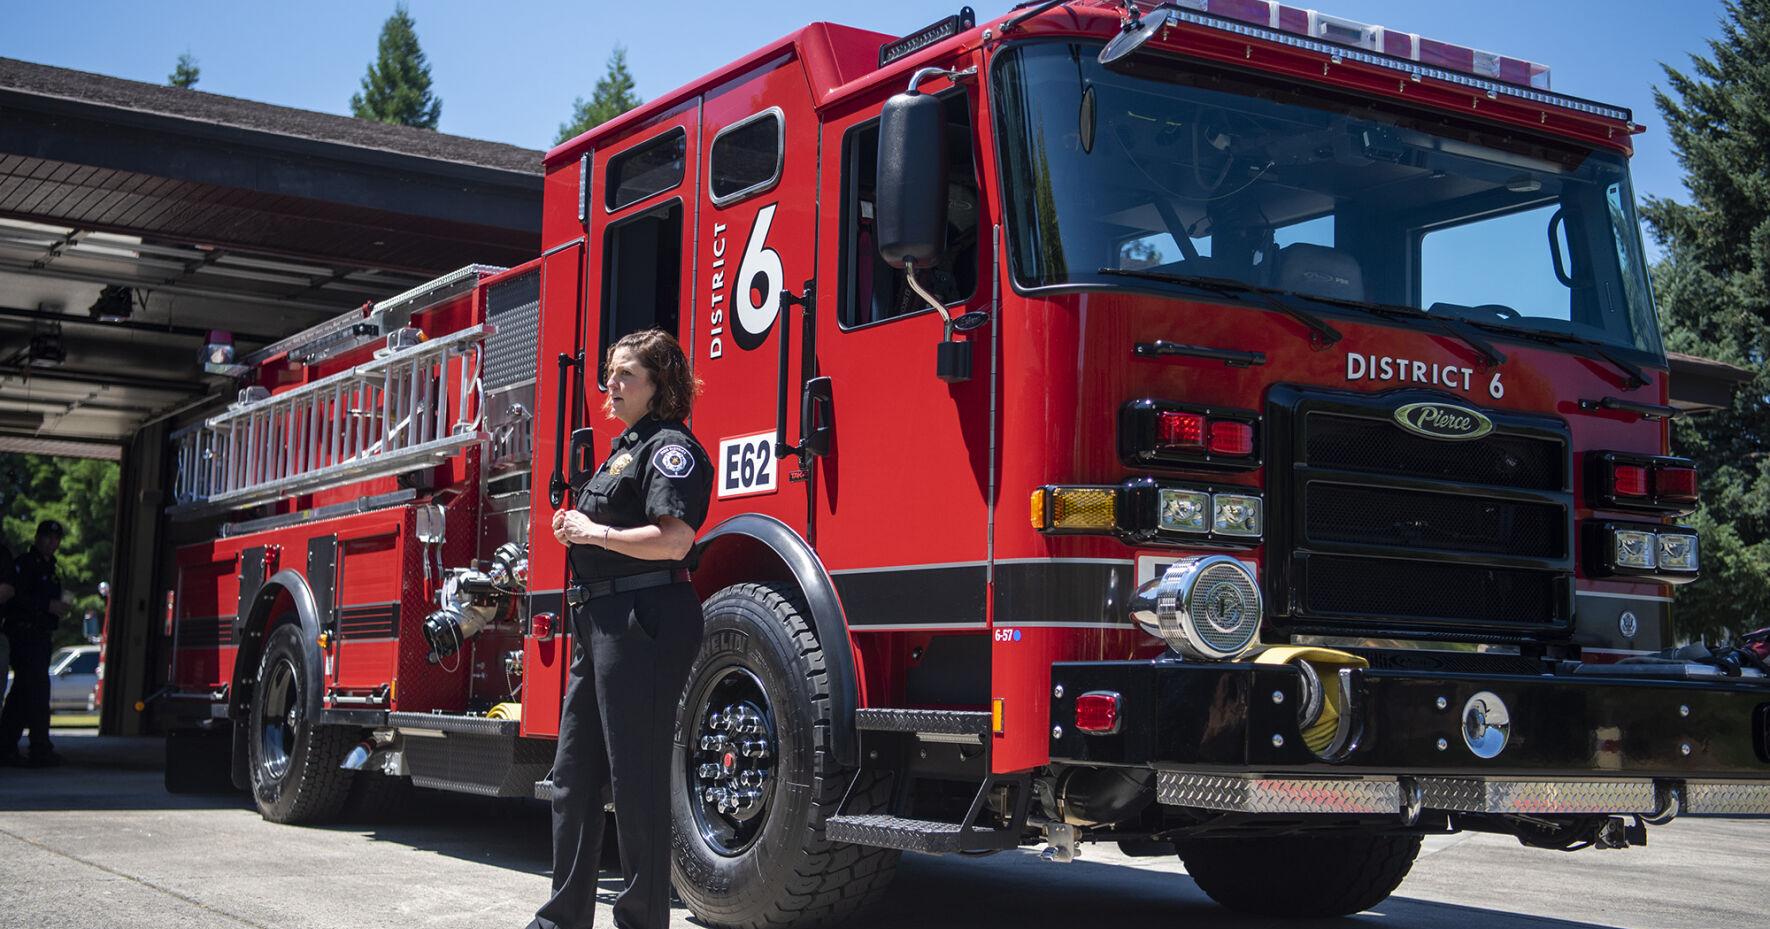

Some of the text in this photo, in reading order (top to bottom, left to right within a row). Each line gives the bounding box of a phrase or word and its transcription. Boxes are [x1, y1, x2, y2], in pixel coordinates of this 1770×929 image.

[710, 223, 727, 359] DISTRICT
[731, 202, 784, 349] 6
[1347, 352, 1505, 399] DISTRICT 6
[1417, 406, 1471, 431] Pierce
[726, 440, 770, 490] E62
[995, 629, 1013, 642] 6-57
